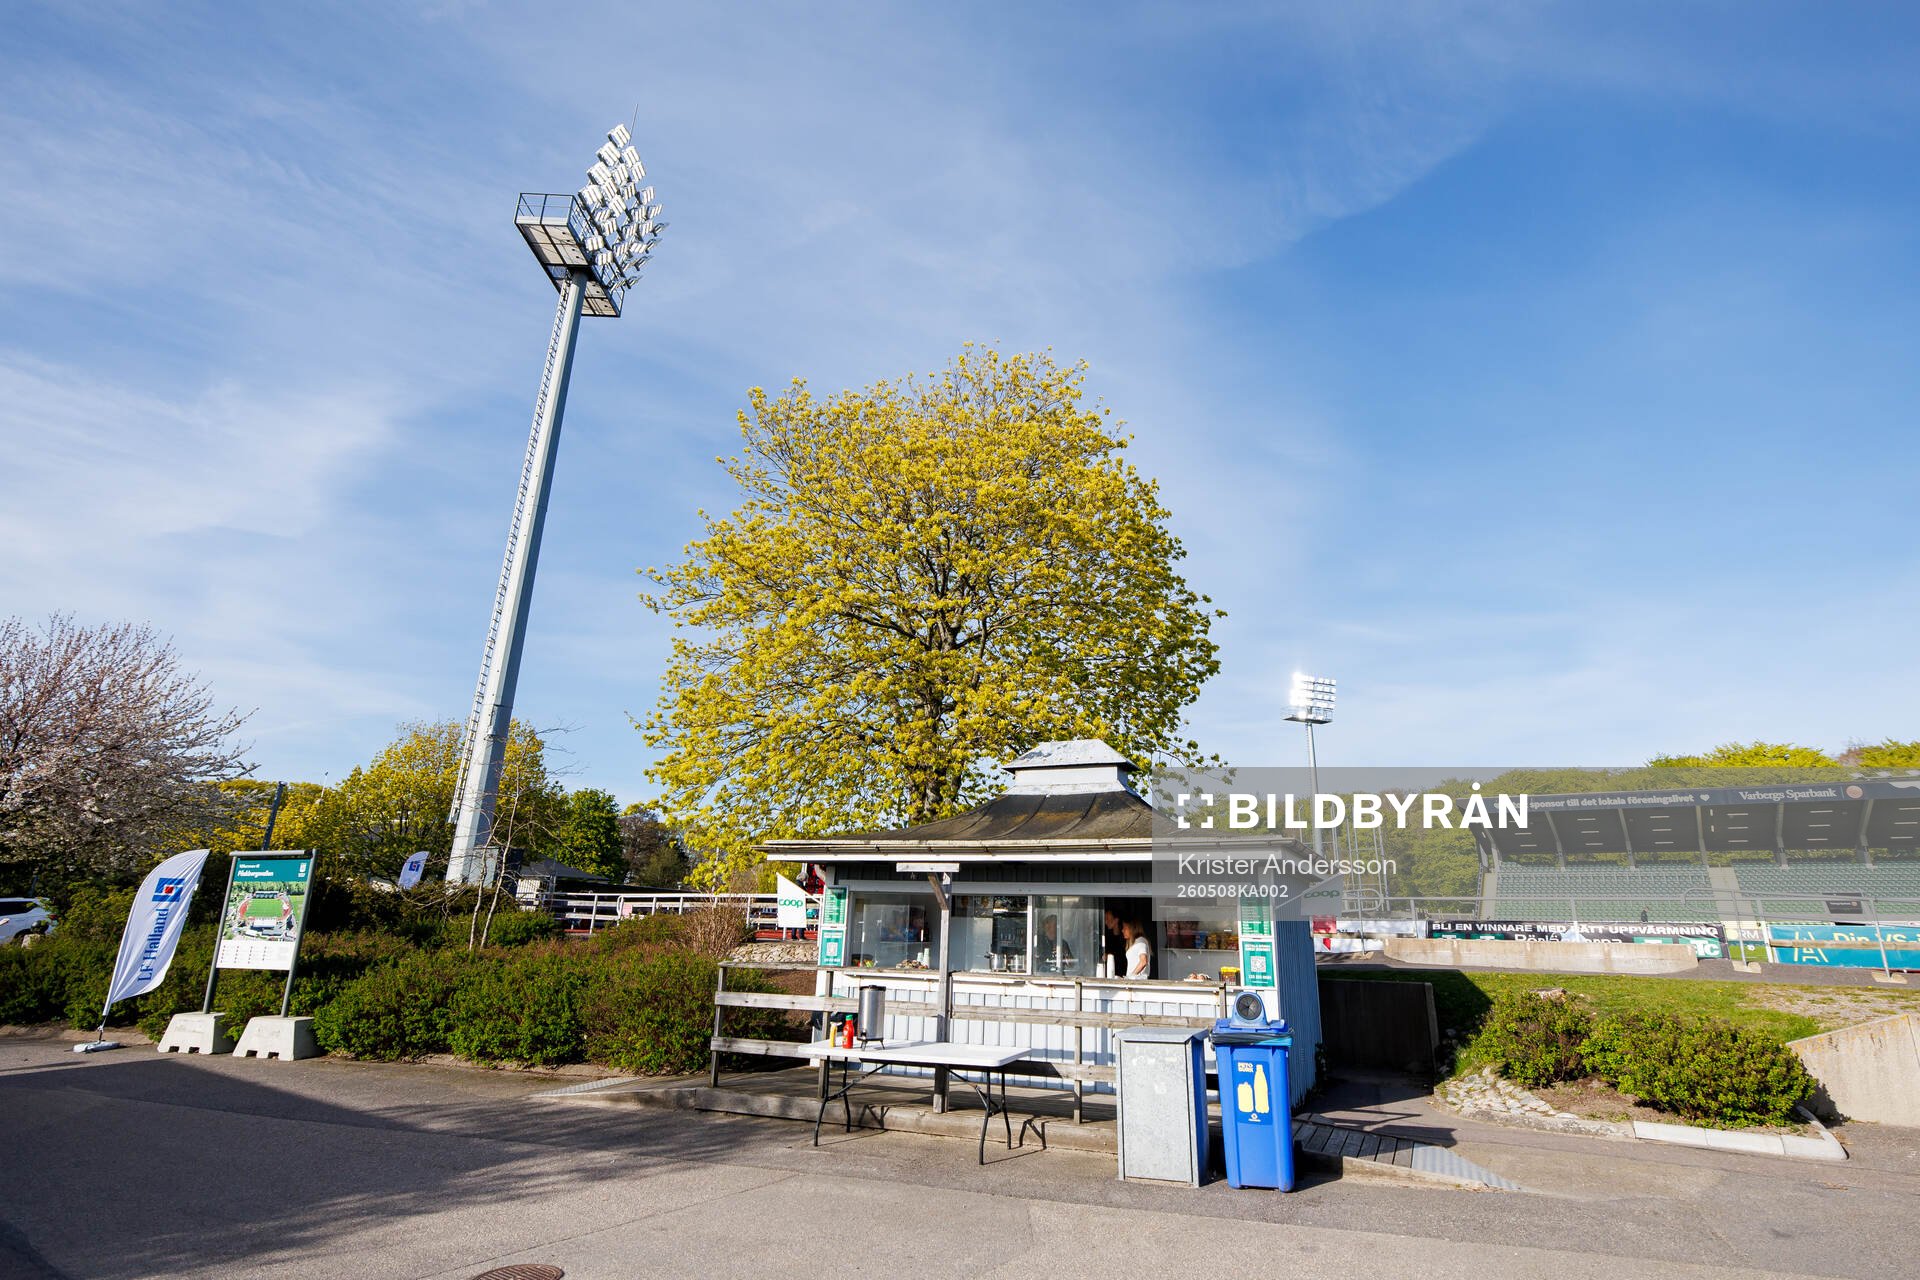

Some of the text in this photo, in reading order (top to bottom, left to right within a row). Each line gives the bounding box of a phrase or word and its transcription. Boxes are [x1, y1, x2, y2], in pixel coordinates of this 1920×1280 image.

[1739, 788, 1837, 801] Varbergs Sparbank
[1530, 799, 1565, 809] sponsor
[1567, 798, 1579, 807] till
[1581, 798, 1597, 806] det
[1598, 797, 1626, 806] lokala
[1627, 795, 1694, 805] föreningslivet
[1304, 890, 1340, 899] coop
[779, 899, 803, 908] coop
[1432, 923, 1451, 931] BLI
[1455, 923, 1472, 931] EN
[1476, 924, 1532, 932] VINNARE
[1536, 924, 1566, 933] MED
[1608, 924, 1718, 938] UPPVÄRMNING
[138, 908, 169, 981] LF Halland
